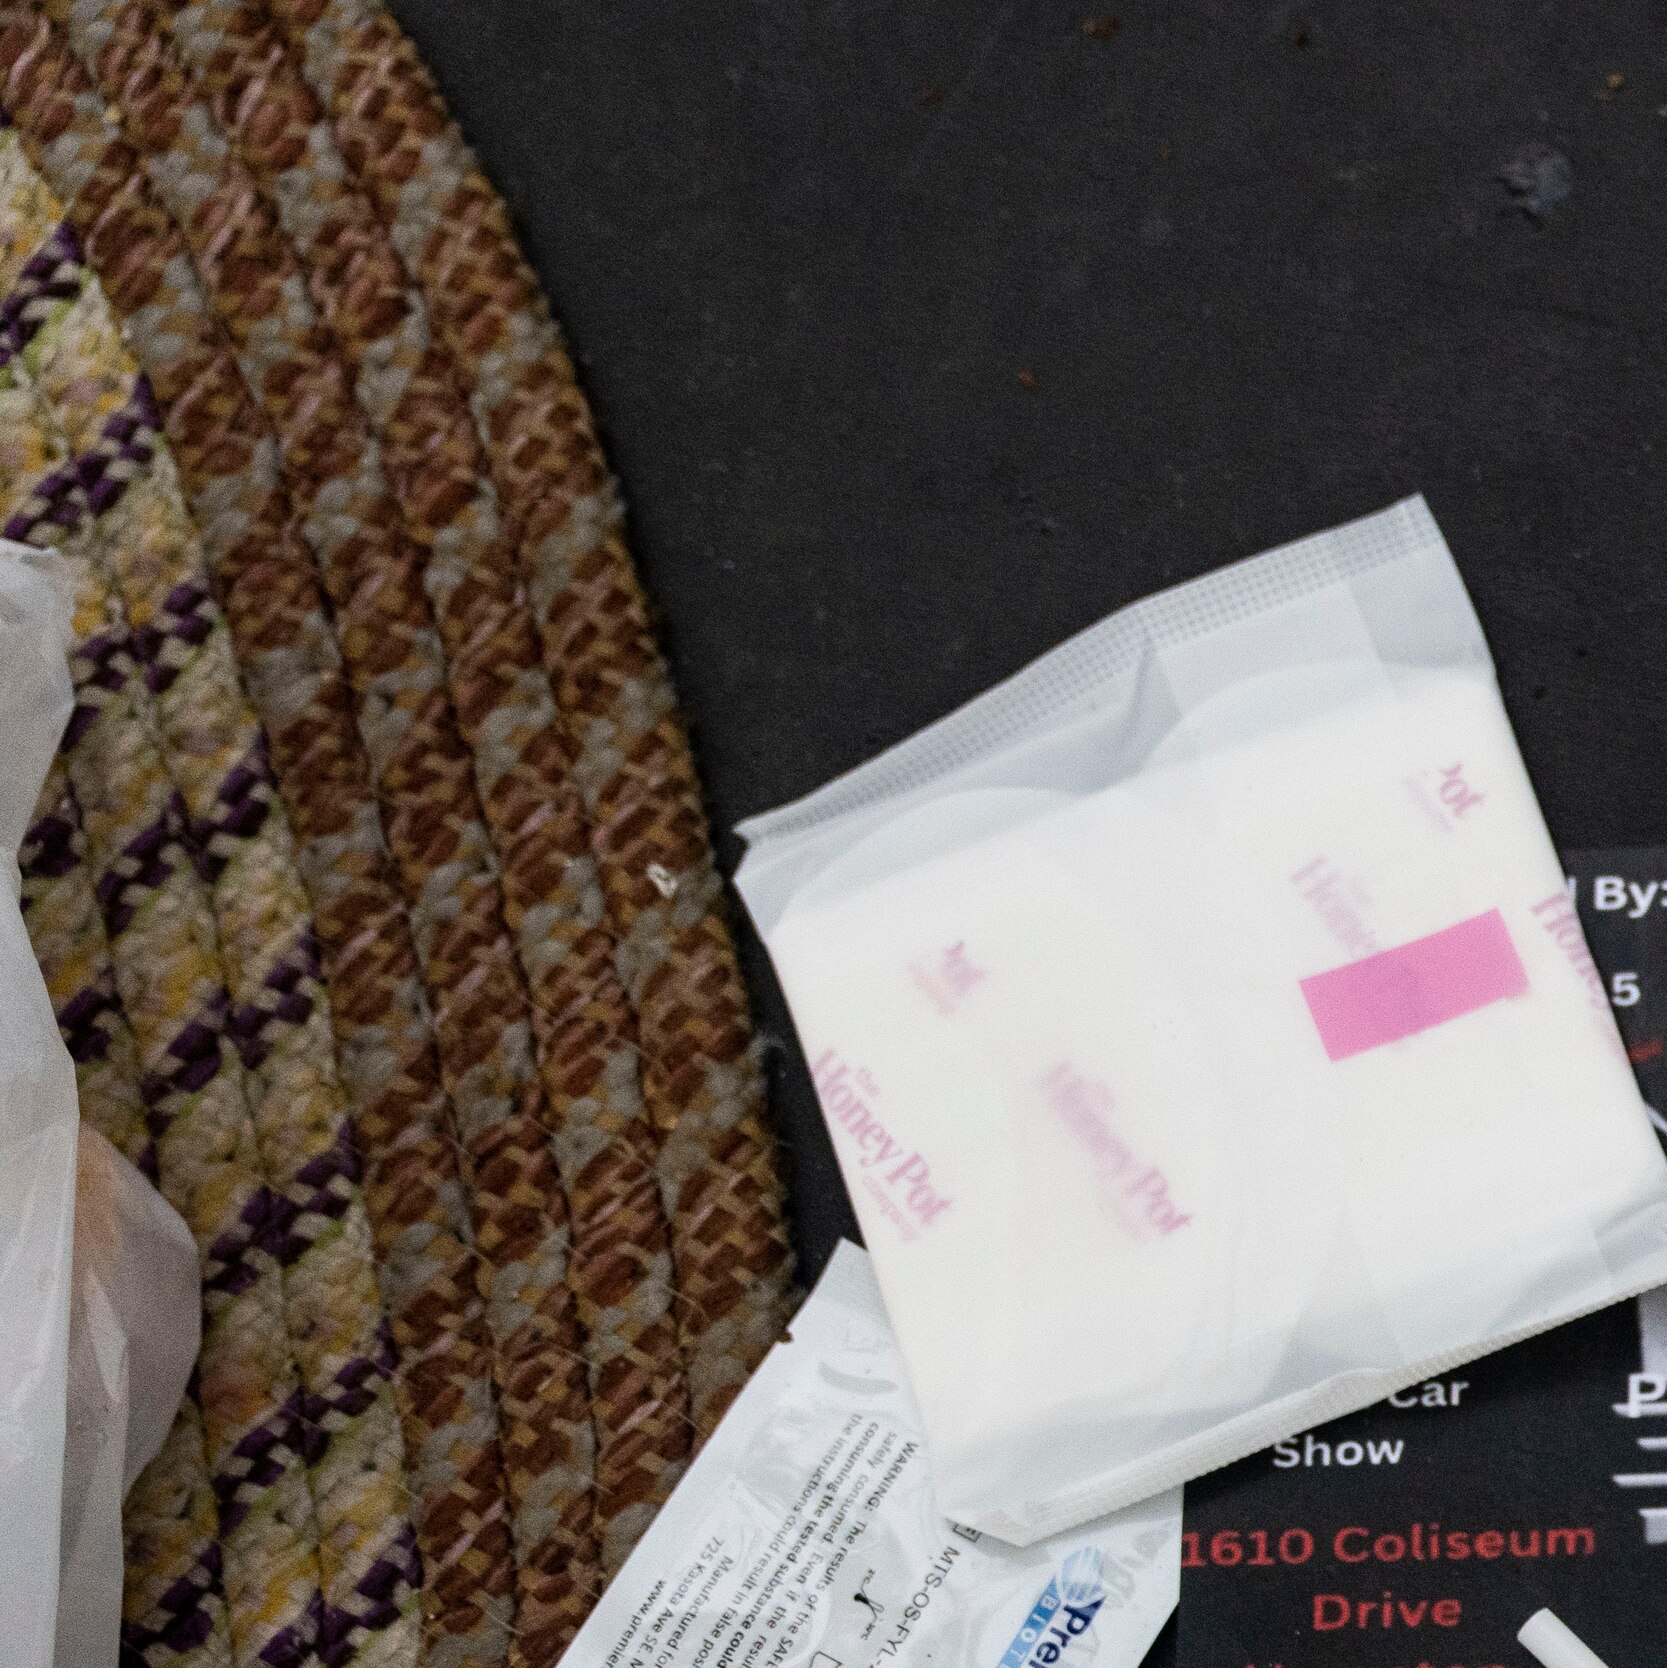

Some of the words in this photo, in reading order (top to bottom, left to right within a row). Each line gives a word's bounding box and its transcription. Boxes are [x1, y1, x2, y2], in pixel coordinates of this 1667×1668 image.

[1612, 974, 1641, 1010] 5
[886, 1148, 957, 1228] Pot
[1385, 1375, 1470, 1414] Car
[1270, 1434, 1405, 1471] Show
[1179, 1527, 1314, 1567] 1610
[1333, 1523, 1595, 1563] Coliseum
[1312, 1591, 1461, 1631] Drive
